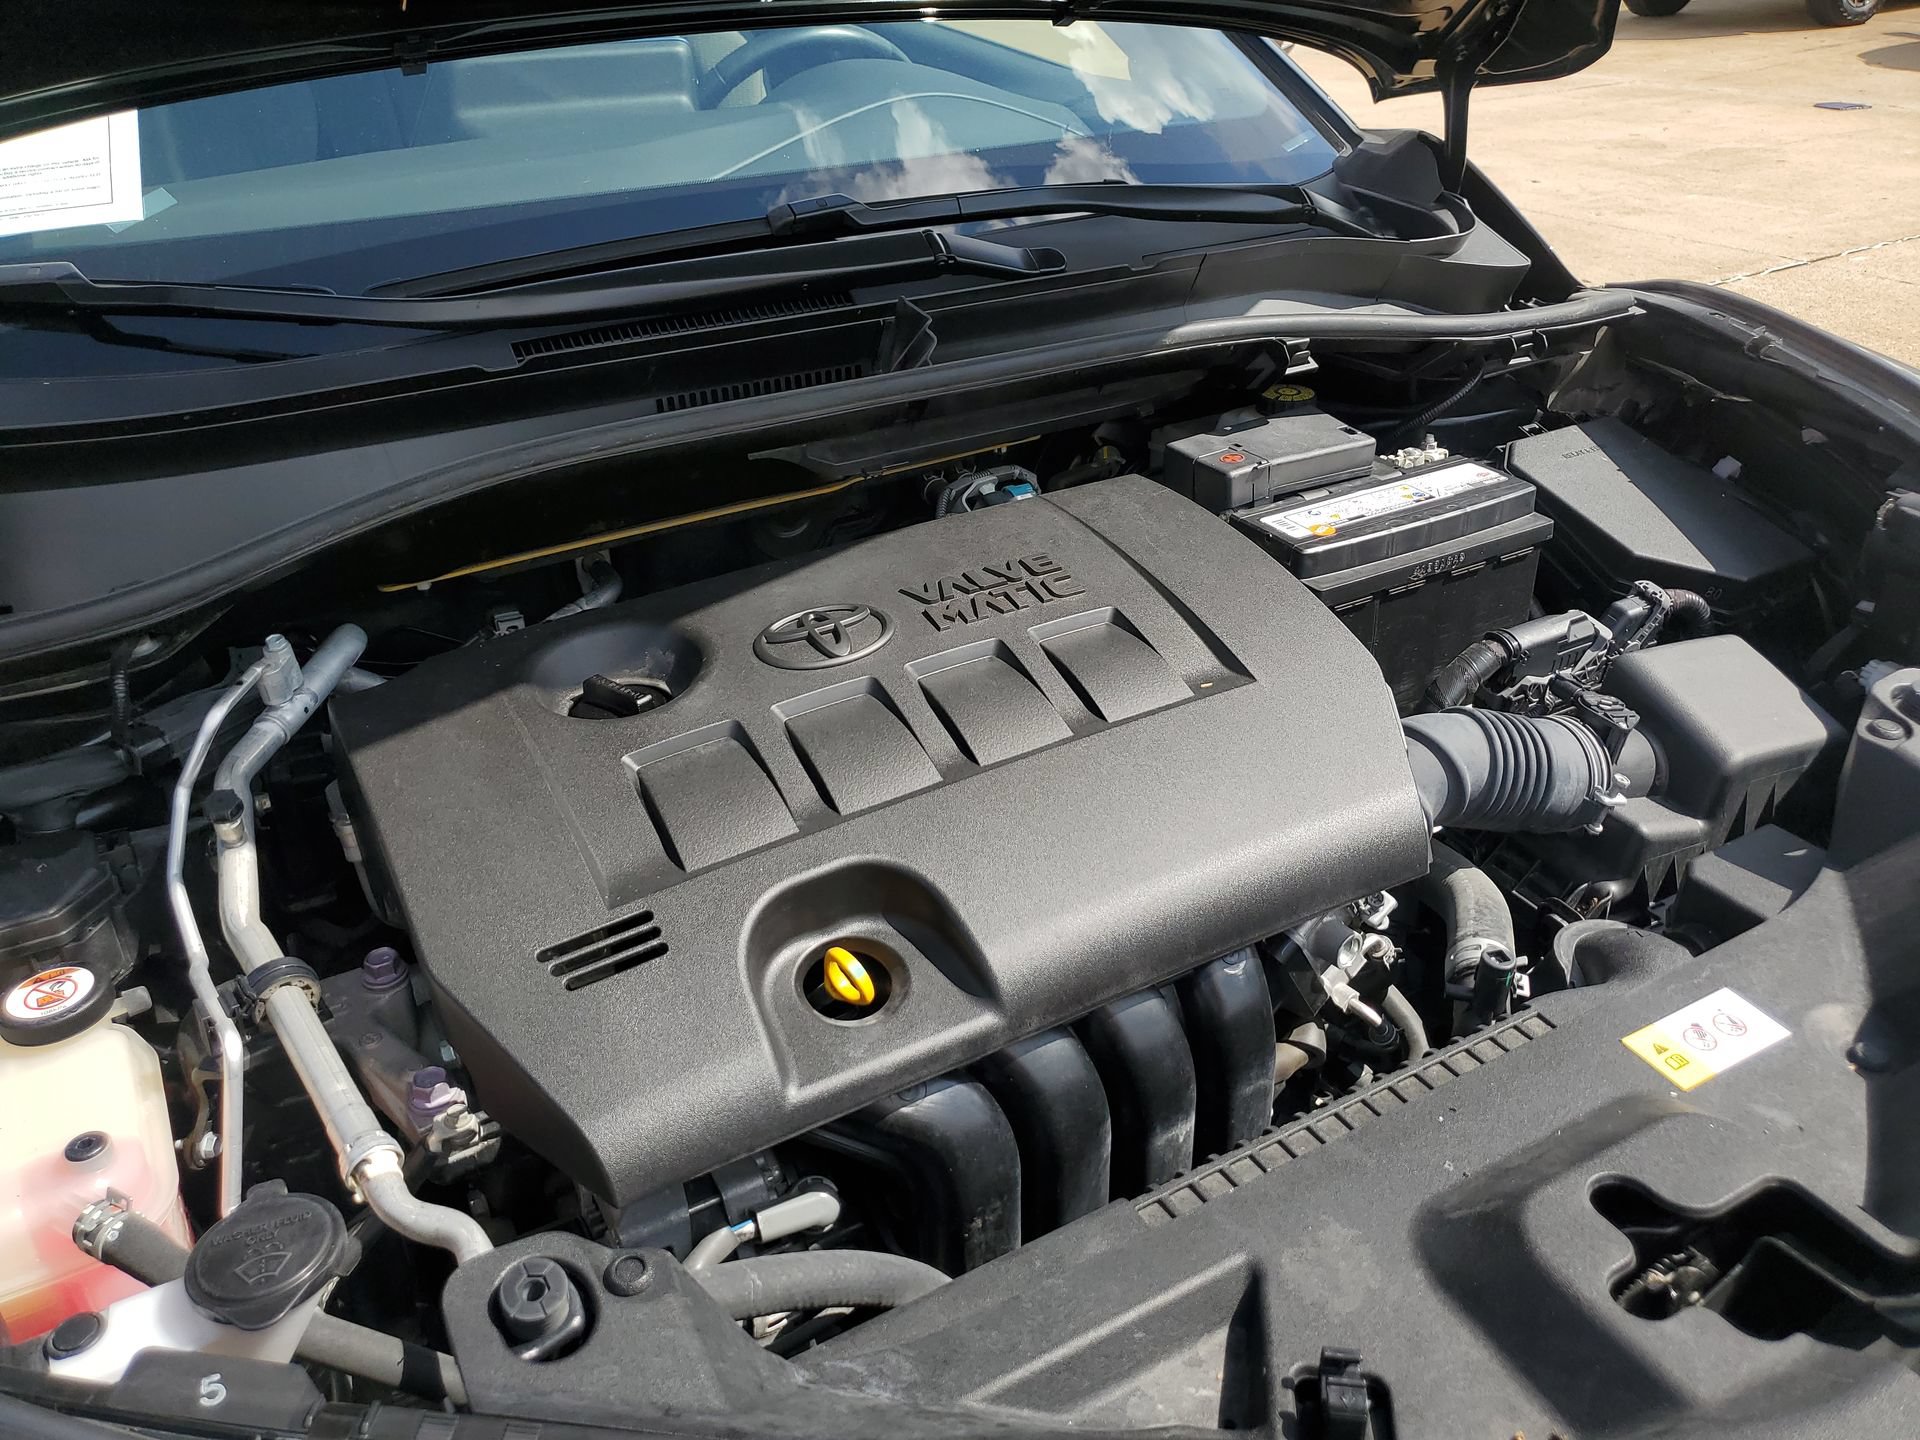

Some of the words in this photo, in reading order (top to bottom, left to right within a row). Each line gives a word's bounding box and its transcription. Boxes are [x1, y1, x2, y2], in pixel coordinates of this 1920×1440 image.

[898, 553, 1063, 605] VALVE
[921, 573, 1086, 632] MATIC
[200, 1373, 227, 1406] 5
